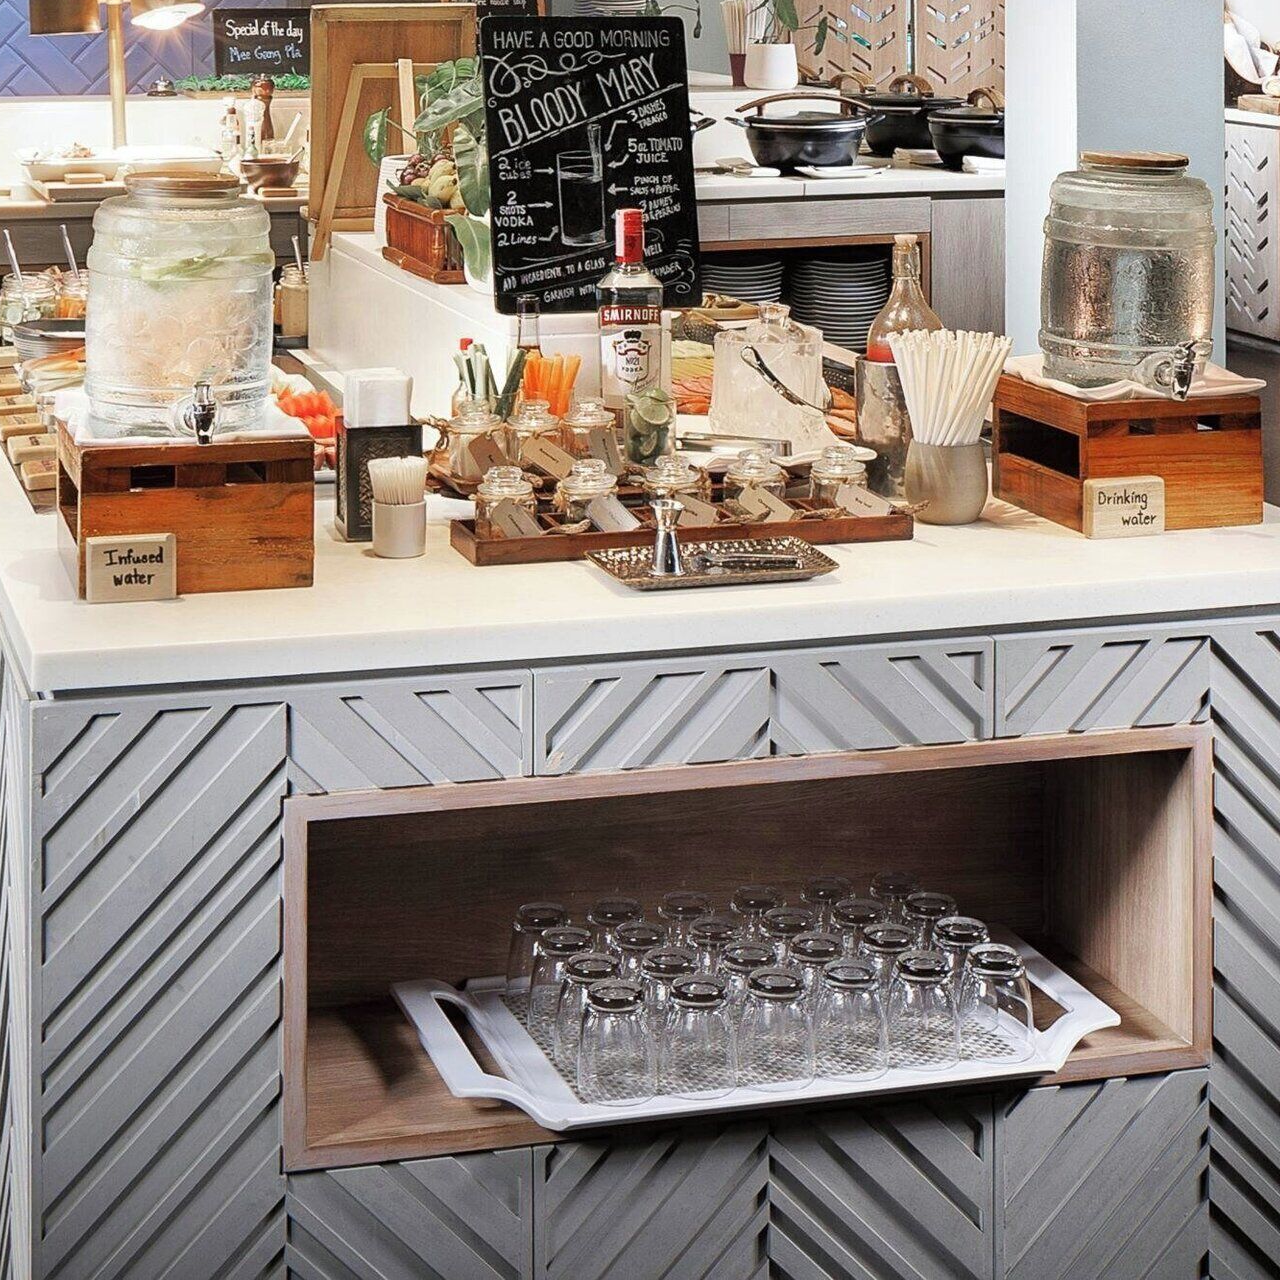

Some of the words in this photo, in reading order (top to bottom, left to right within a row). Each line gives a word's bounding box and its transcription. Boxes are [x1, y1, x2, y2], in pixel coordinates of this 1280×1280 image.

[225, 19, 259, 40] Special
[260, 20, 271, 36] of
[271, 21, 284, 36] the
[286, 20, 303, 43] day
[494, 31, 534, 49] HAVE
[539, 31, 549, 49] A
[554, 31, 594, 49] GOOD
[601, 30, 670, 47] MORNING
[229, 46, 251, 62] Mee
[284, 43, 302, 59] Pla
[498, 81, 588, 147] BLOODY
[596, 52, 660, 107] MARY
[626, 110, 638, 121] 3
[638, 98, 666, 117] DASHES
[648, 137, 683, 152] TOMATO
[498, 157, 511, 170] 2
[514, 158, 531, 170] ice
[636, 152, 669, 163] JUICE
[499, 170, 532, 180] cubes
[662, 174, 673, 183] OF
[507, 190, 517, 205] 2
[500, 205, 526, 215] SHOTS
[494, 215, 534, 227] VODKA
[498, 233, 510, 246] 2
[643, 243, 662, 257] WELL
[566, 264, 575, 274] TO
[578, 262, 582, 270] A
[584, 257, 605, 270] GLASS
[604, 308, 659, 321] SMIRNOFF
[1098, 489, 1148, 510] Drinking
[1122, 510, 1156, 526] water
[103, 546, 163, 566] Infused
[113, 568, 155, 586] water
